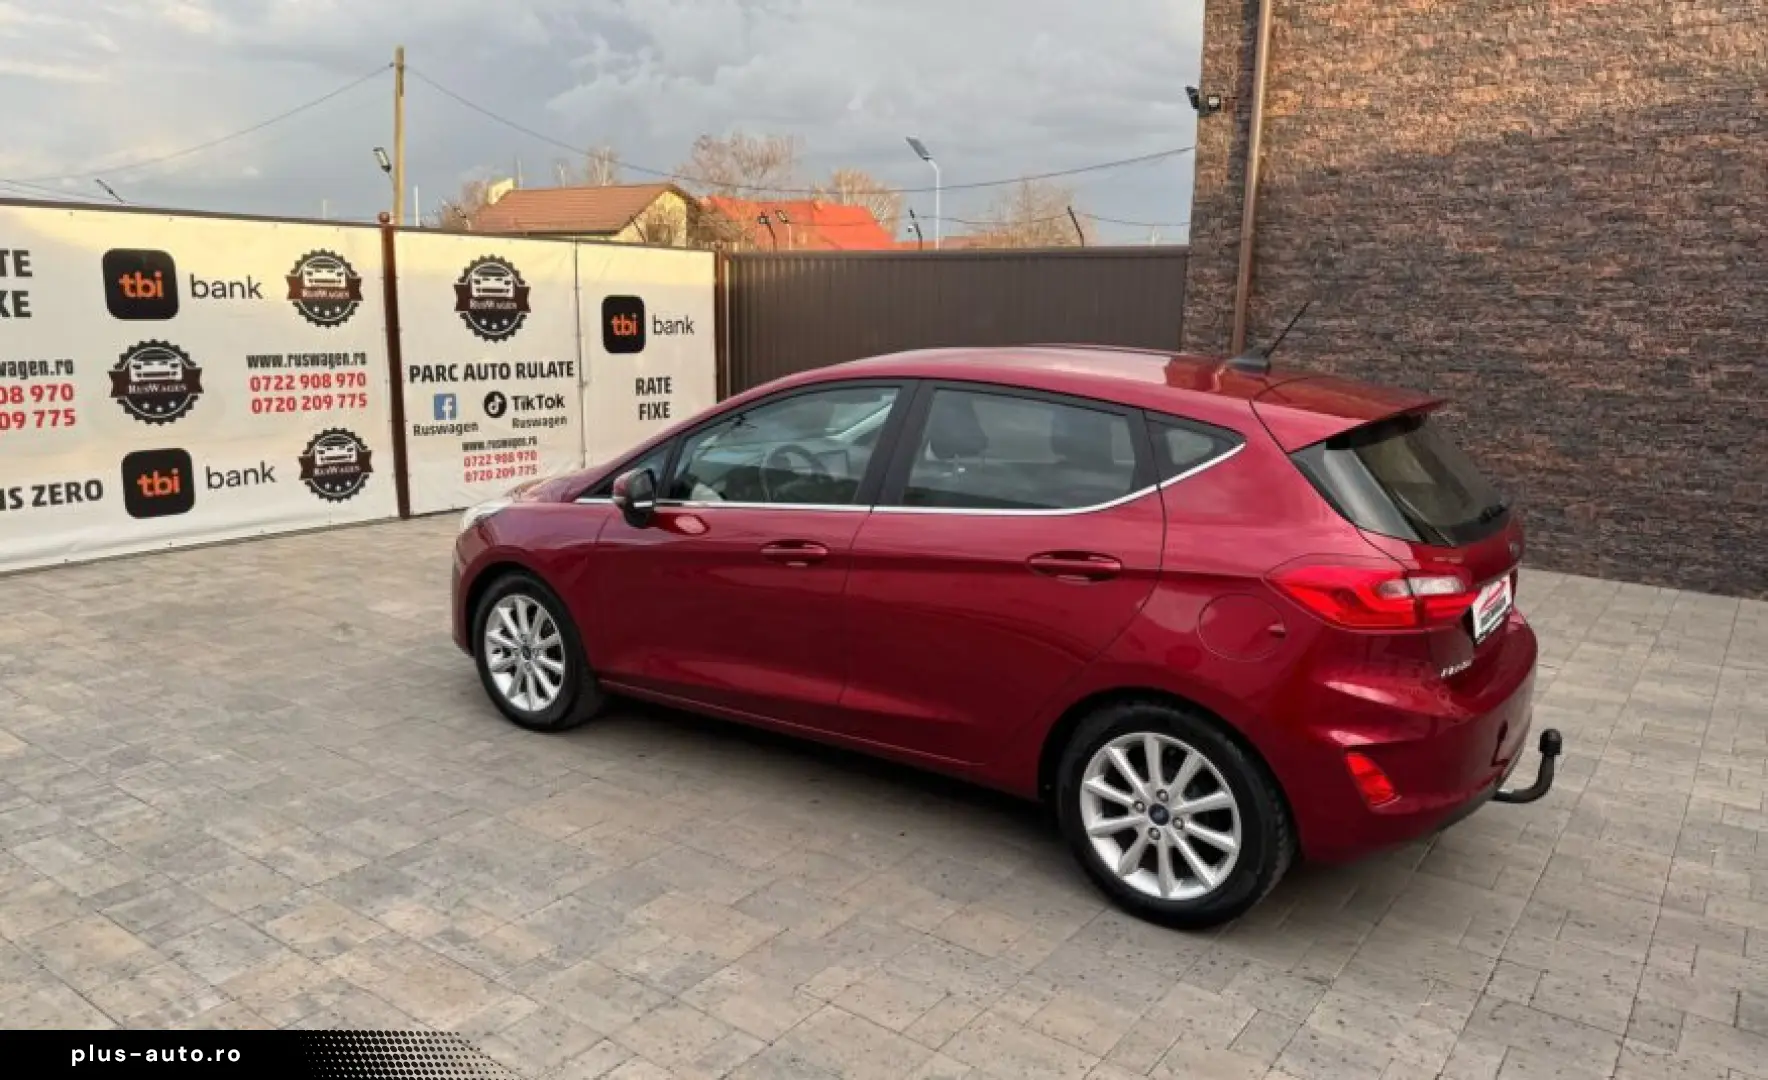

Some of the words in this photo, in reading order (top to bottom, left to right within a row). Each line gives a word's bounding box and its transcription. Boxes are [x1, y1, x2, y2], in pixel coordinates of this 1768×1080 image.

[119, 272, 164, 298] tbi
[190, 274, 264, 300] bank
[611, 313, 638, 336] tbi
[652, 315, 695, 335] bank
[246, 352, 367, 369] www.ruswagen.ro
[250, 375, 295, 393] 0722
[300, 373, 332, 390] 908
[336, 371, 367, 388] 970
[409, 364, 458, 384] PARC
[464, 362, 511, 381] AUTO
[516, 360, 575, 379] RULATE
[30, 384, 74, 403] 970
[635, 377, 672, 396] RATE
[251, 396, 297, 415] 0720
[301, 394, 334, 411] 209
[337, 392, 368, 409] 775
[511, 394, 565, 411] TikTok
[639, 401, 670, 420] FIXE
[33, 407, 76, 429] 775
[138, 469, 180, 497] tbi
[206, 461, 276, 490] bank
[31, 478, 103, 508] ZERO
